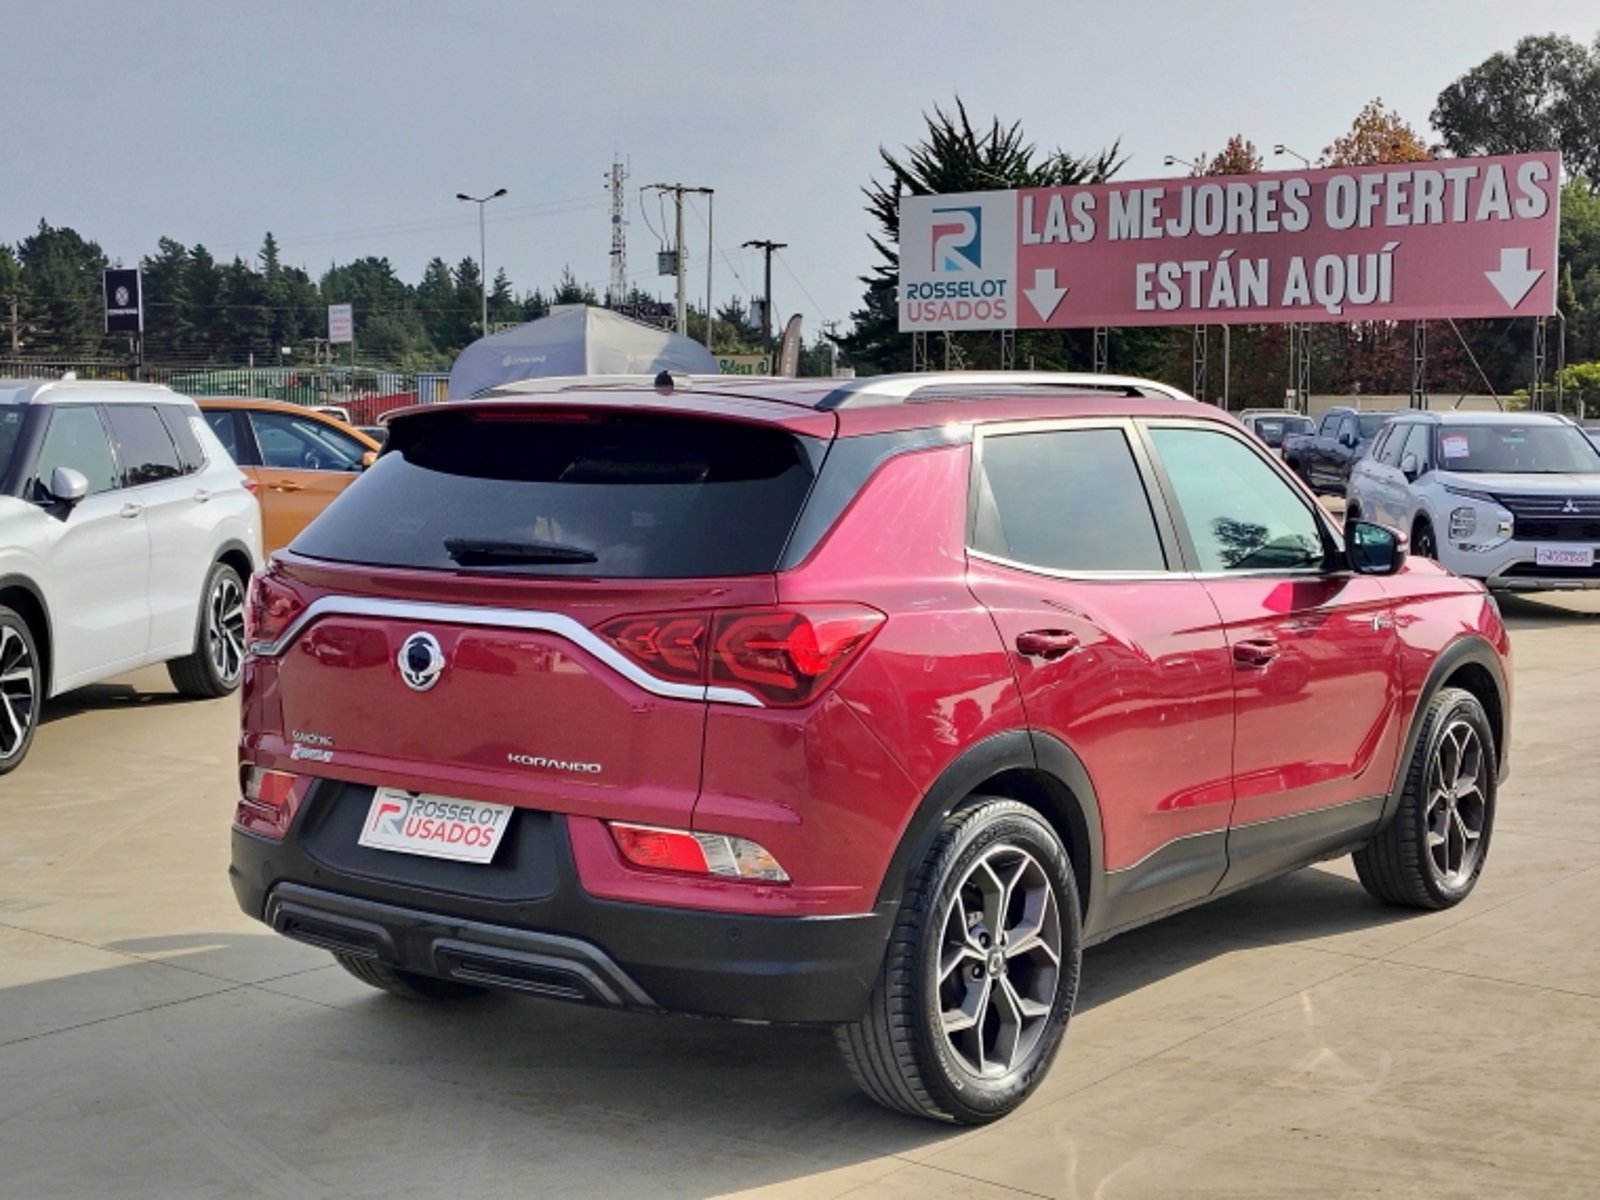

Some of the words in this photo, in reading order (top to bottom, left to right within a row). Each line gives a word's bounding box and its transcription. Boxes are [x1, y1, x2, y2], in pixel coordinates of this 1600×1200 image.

[1022, 191, 1098, 245] LAS
[1108, 177, 1311, 241] MEJORES
[1325, 160, 1550, 230] OFERTAS
[906, 279, 1008, 300] ROSSELOT
[1135, 249, 1269, 311] ESTÁN
[1281, 241, 1401, 315] AQUÍ
[906, 299, 1008, 322] USADOS
[507, 753, 602, 773] KORANDO
[411, 800, 504, 826] ROSSELOT
[405, 818, 495, 847] USADOS
